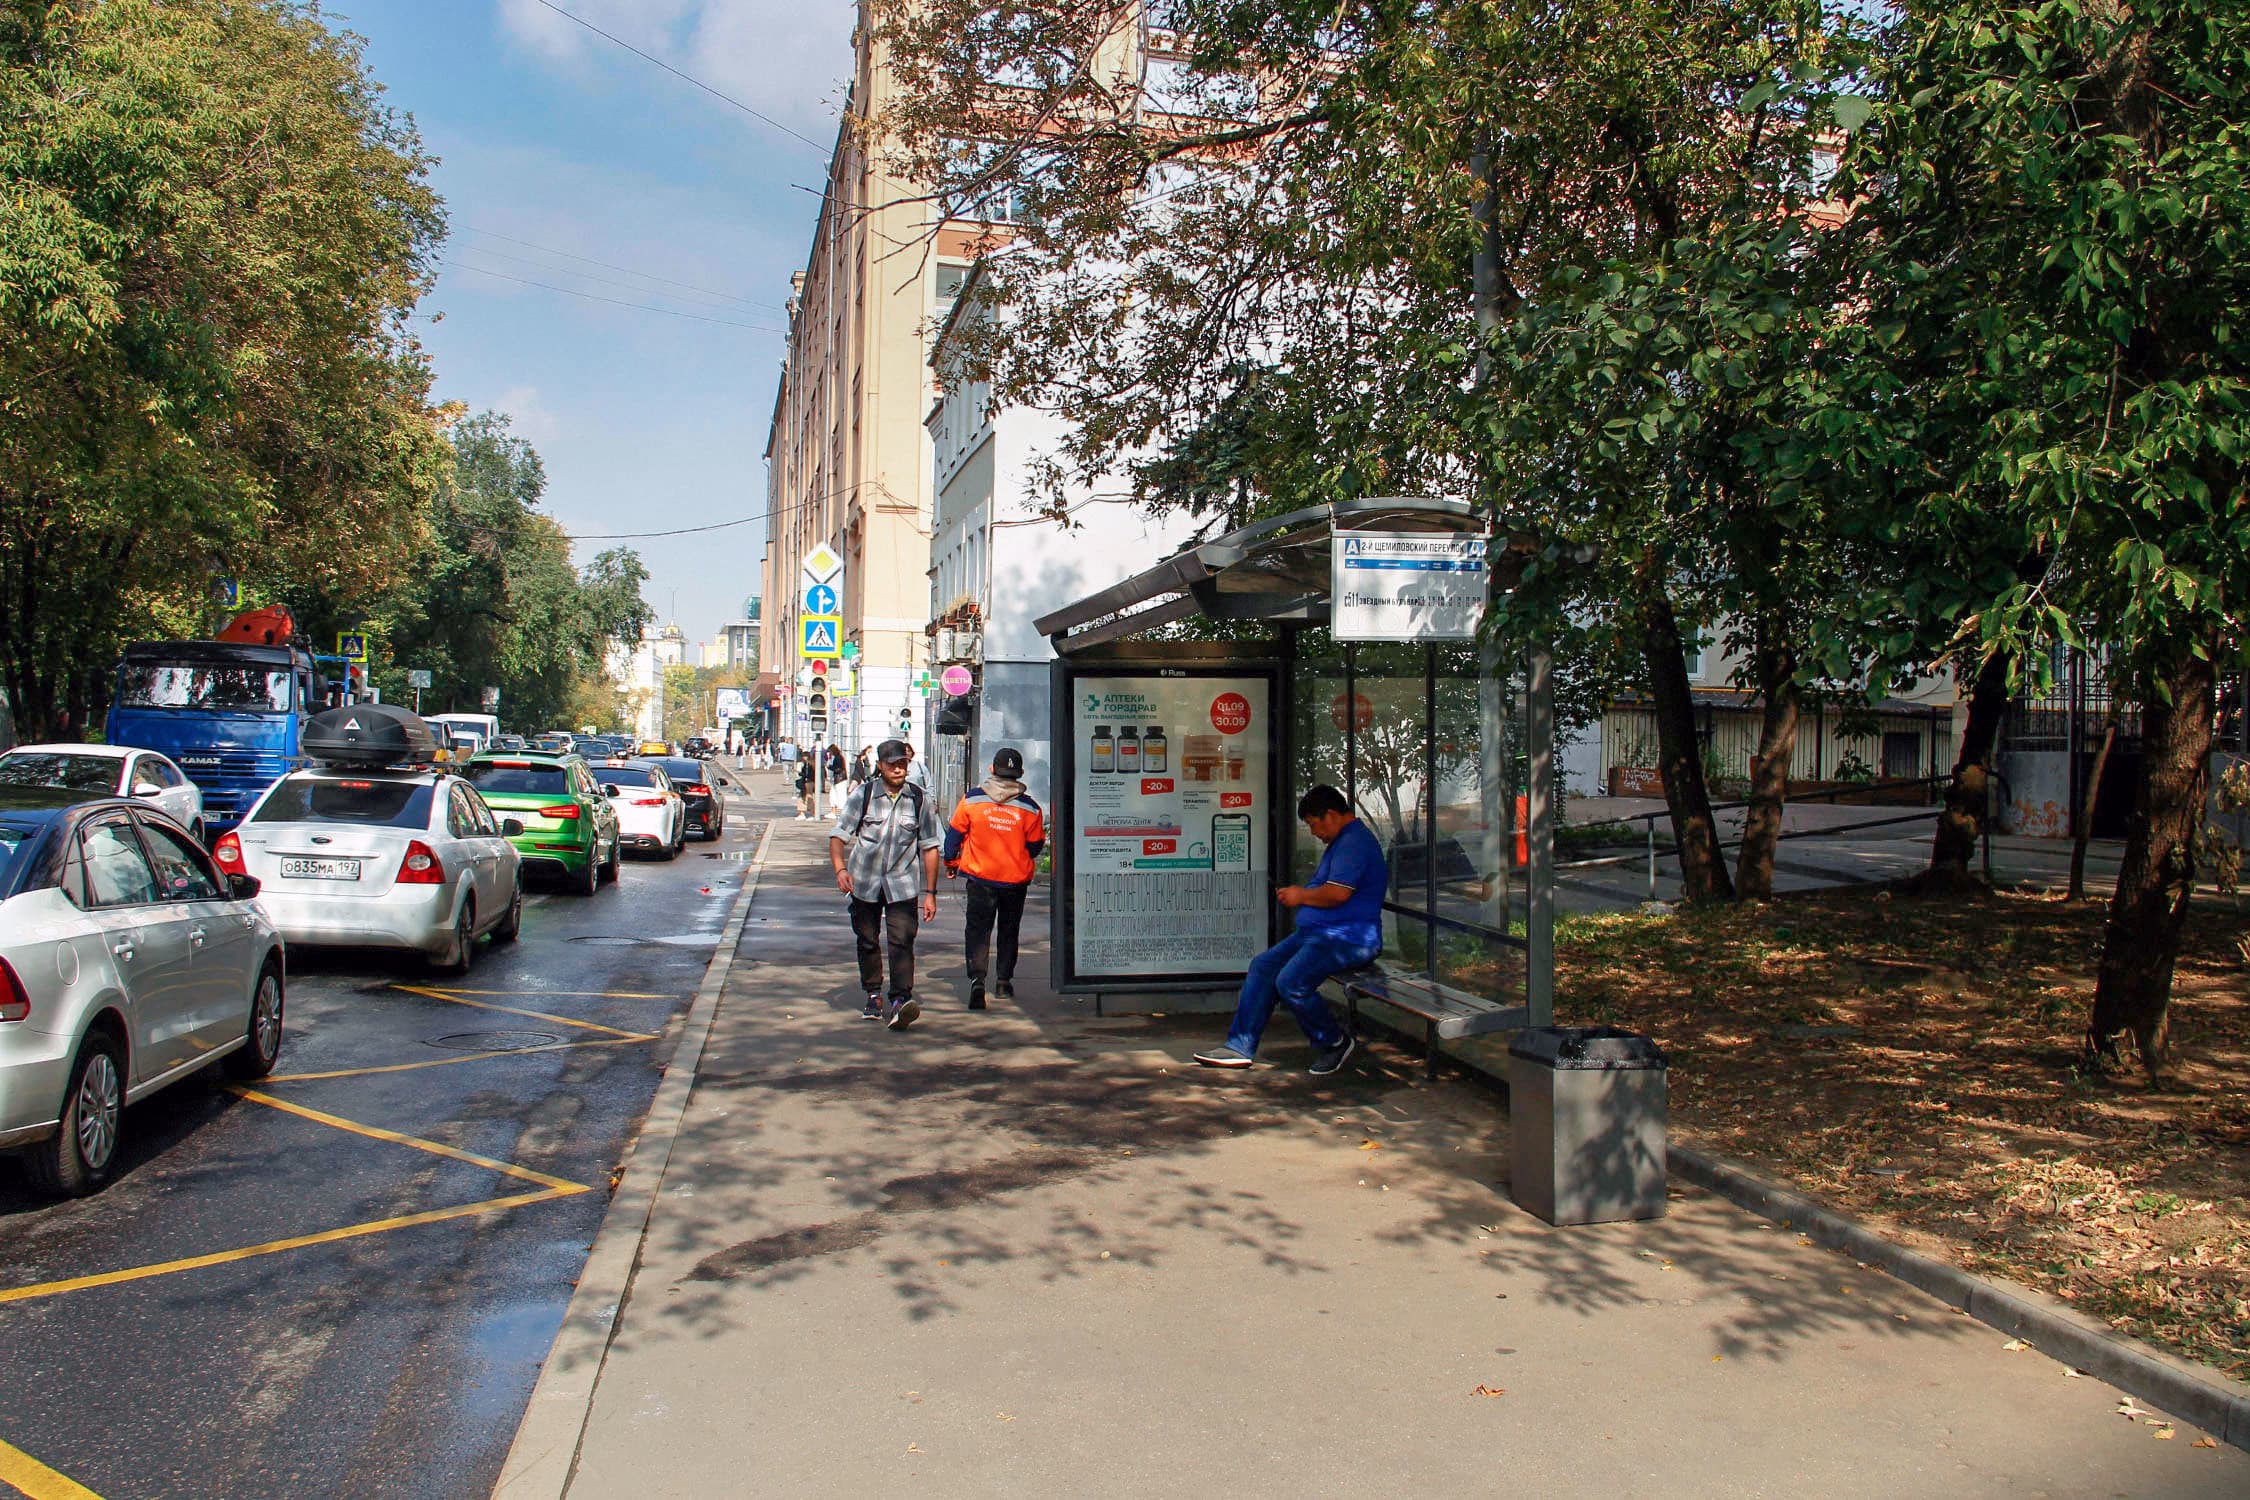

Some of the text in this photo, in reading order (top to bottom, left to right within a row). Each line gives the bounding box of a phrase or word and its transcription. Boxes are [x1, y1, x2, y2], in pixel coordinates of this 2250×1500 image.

[1361, 541, 1373, 550] 2-Й
[1374, 542, 1428, 552] ЩЕМИЛОВСКИЙ
[1429, 543, 1465, 553] ПЕРЕУЛОК
[1104, 694, 1145, 702] АПТЕКИ
[1104, 704, 1157, 713] ГОРЗДРАВ
[1217, 702, 1245, 712] 01.09
[1216, 717, 1246, 726] 30.09
[989, 823, 1012, 832] РАЙОНА
[338, 862, 357, 873] 197
